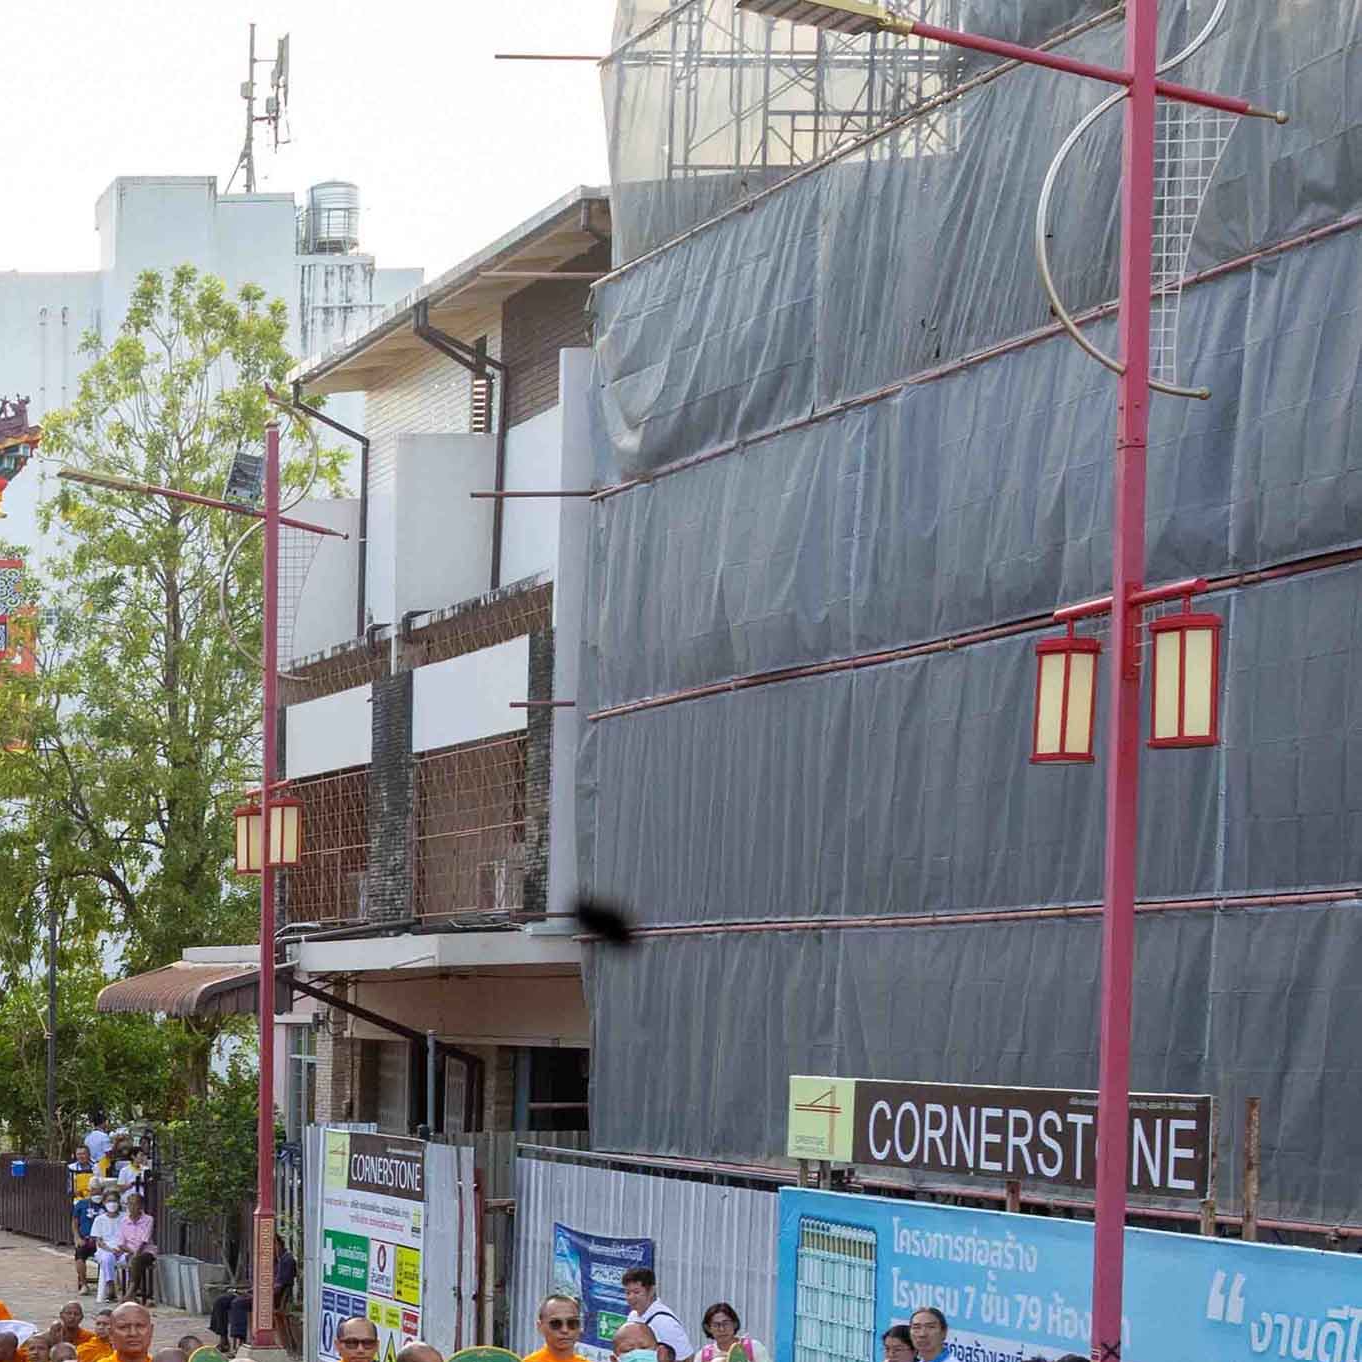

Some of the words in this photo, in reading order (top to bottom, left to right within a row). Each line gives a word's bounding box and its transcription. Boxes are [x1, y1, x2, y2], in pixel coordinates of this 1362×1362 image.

[350, 1152, 422, 1193] CORNERSTONE
[868, 1100, 1198, 1191] CORNERSTNE
[892, 1216, 1038, 1273] โครงการก่อสร้าง
[964, 1287, 975, 1319] 7
[980, 1270, 1010, 1328] ชั้น
[1014, 1295, 1043, 1333] 79
